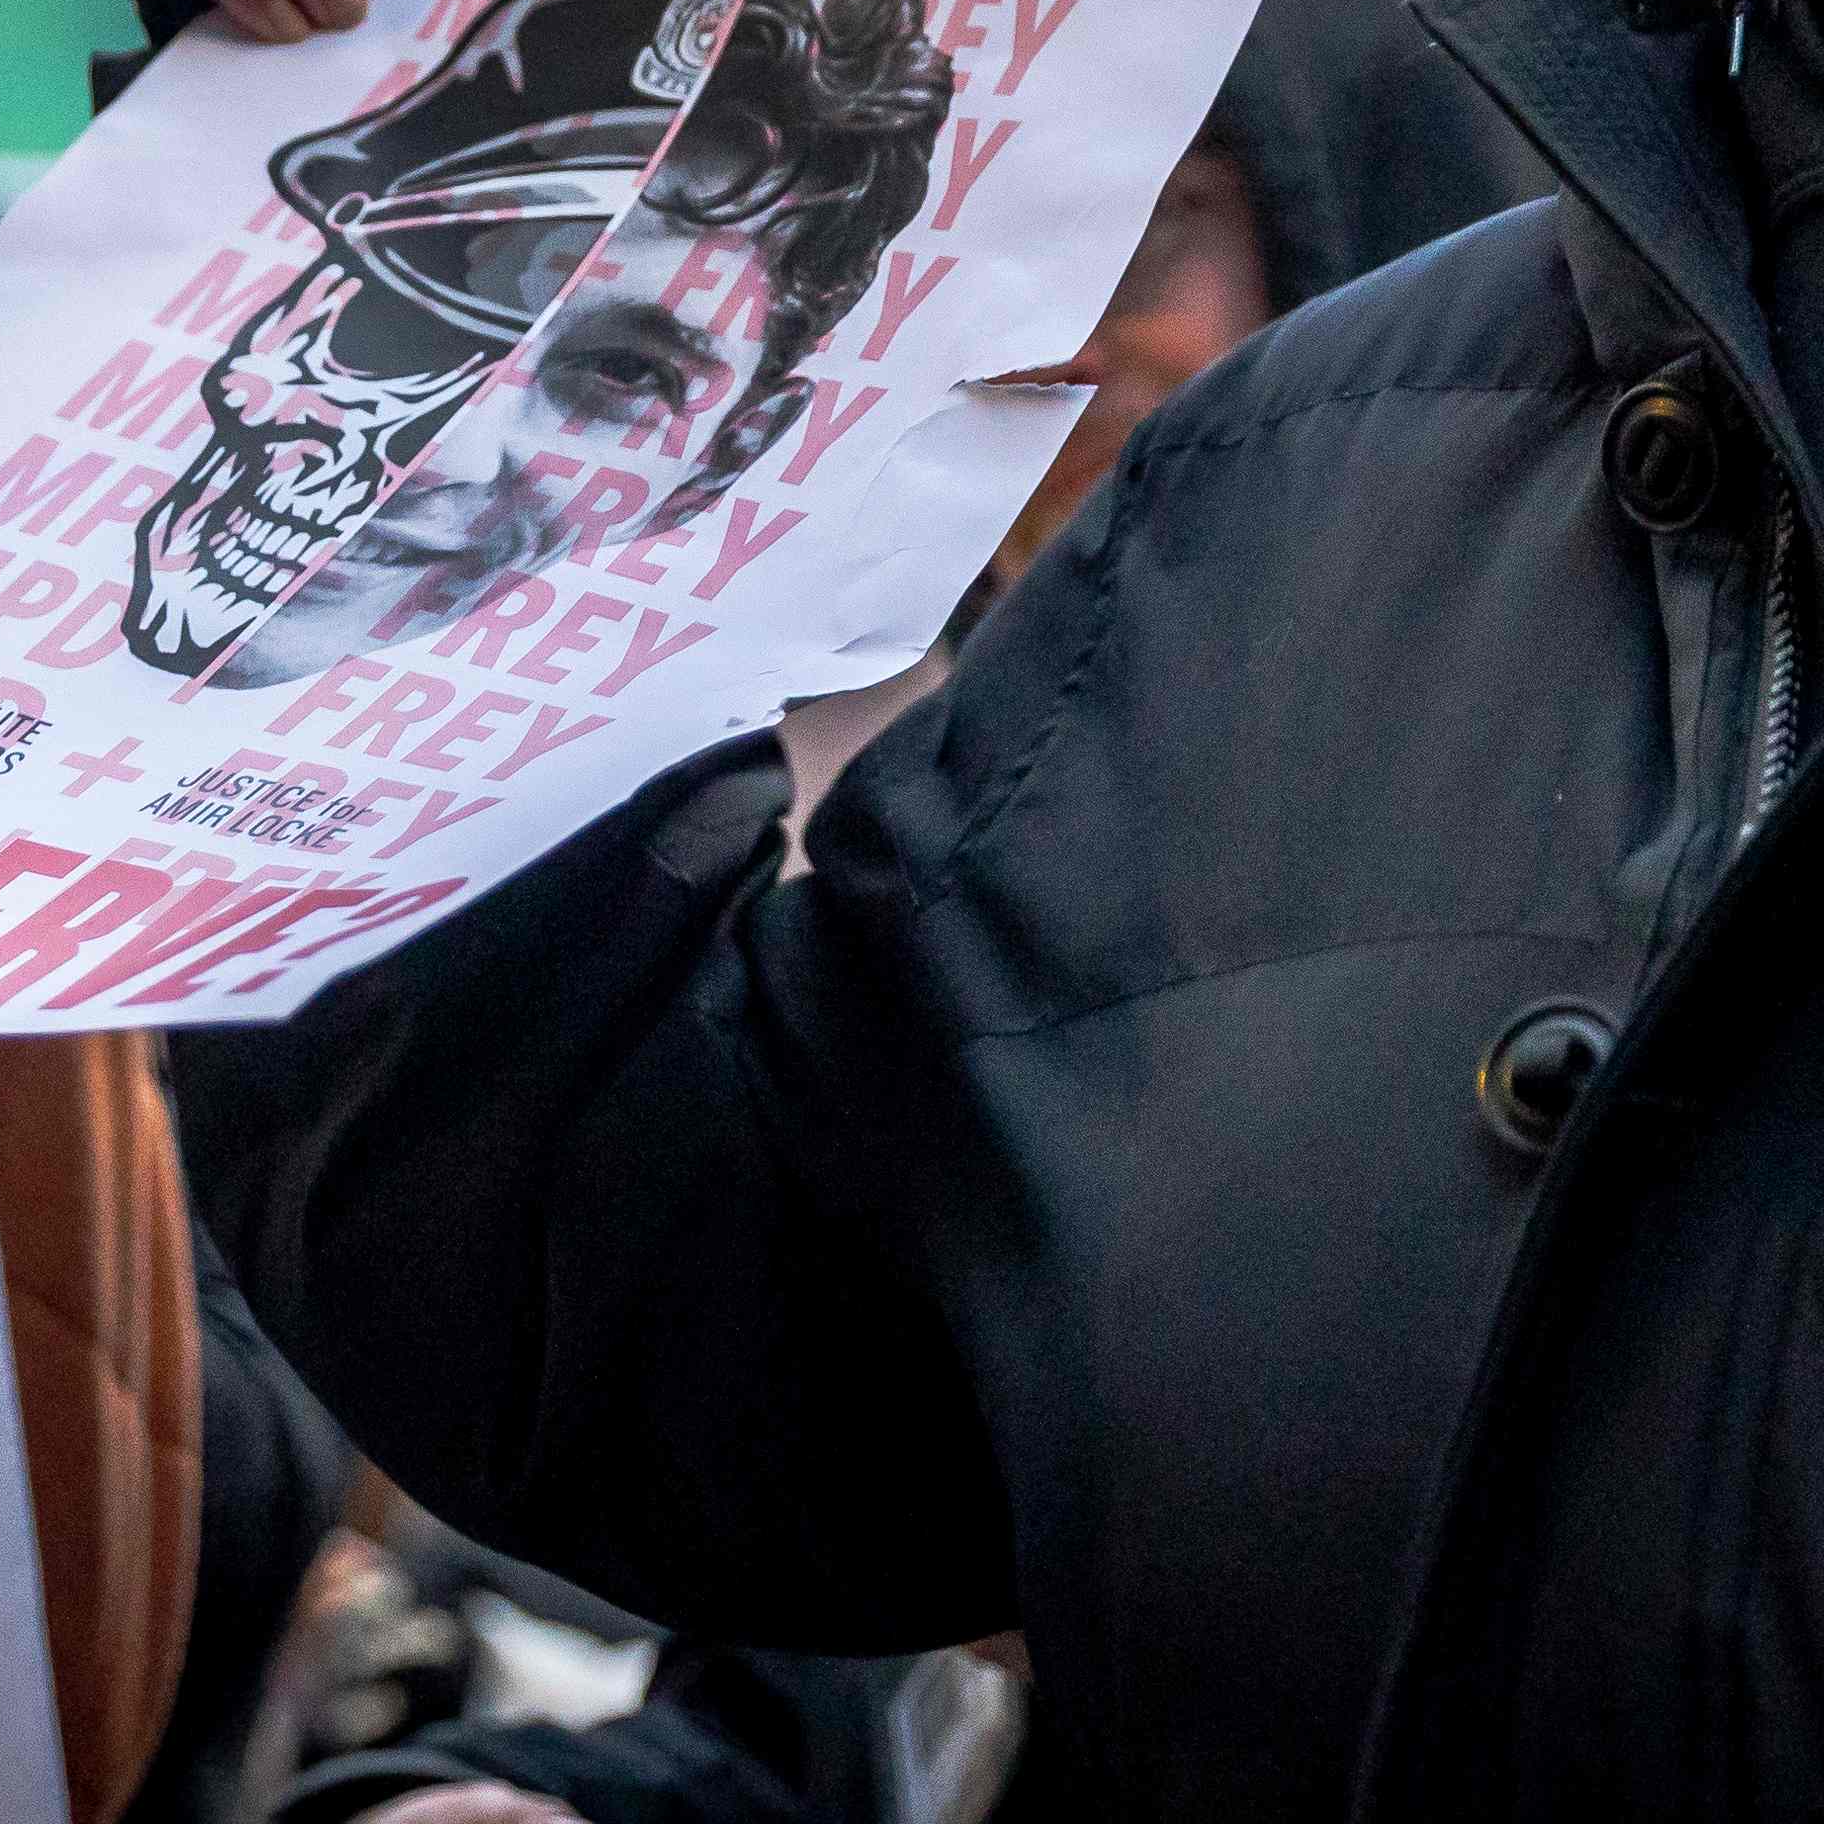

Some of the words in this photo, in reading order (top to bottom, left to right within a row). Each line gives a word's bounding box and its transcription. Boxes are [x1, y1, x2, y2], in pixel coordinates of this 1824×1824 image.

[367, 561, 719, 699] FREY
[264, 654, 616, 782] FREY
[59, 736, 145, 798] +
[177, 766, 328, 814] JUSTICE
[318, 796, 372, 824] for
[139, 792, 235, 830] AMIR
[230, 806, 349, 851] LOCKE
